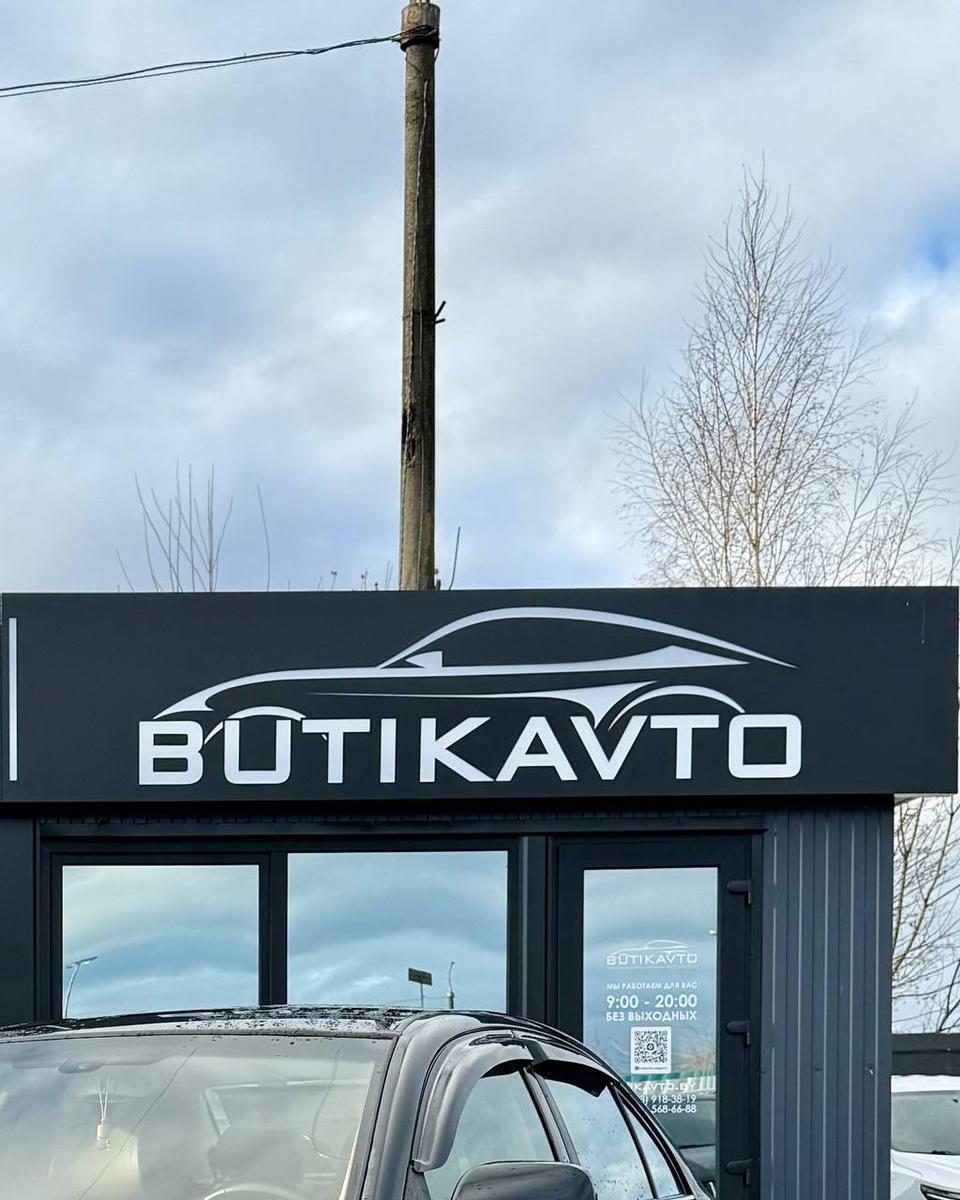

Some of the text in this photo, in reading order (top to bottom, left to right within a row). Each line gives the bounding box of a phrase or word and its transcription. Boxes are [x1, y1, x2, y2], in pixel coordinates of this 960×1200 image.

[139, 712, 803, 786] BUTIKAVTO
[606, 953, 698, 966] BUTIKAVTO
[621, 982, 662, 990] РАБОТАЕМ
[681, 981, 698, 989] ВАС
[606, 995, 639, 1009] 9:00
[654, 993, 698, 1008] 20:00
[606, 1010, 697, 1022] БЕЗ ВЫХОДНЫХ
[651, 1093, 697, 1104] 918-38-19
[651, 1104, 697, 1114] 568-66-88
